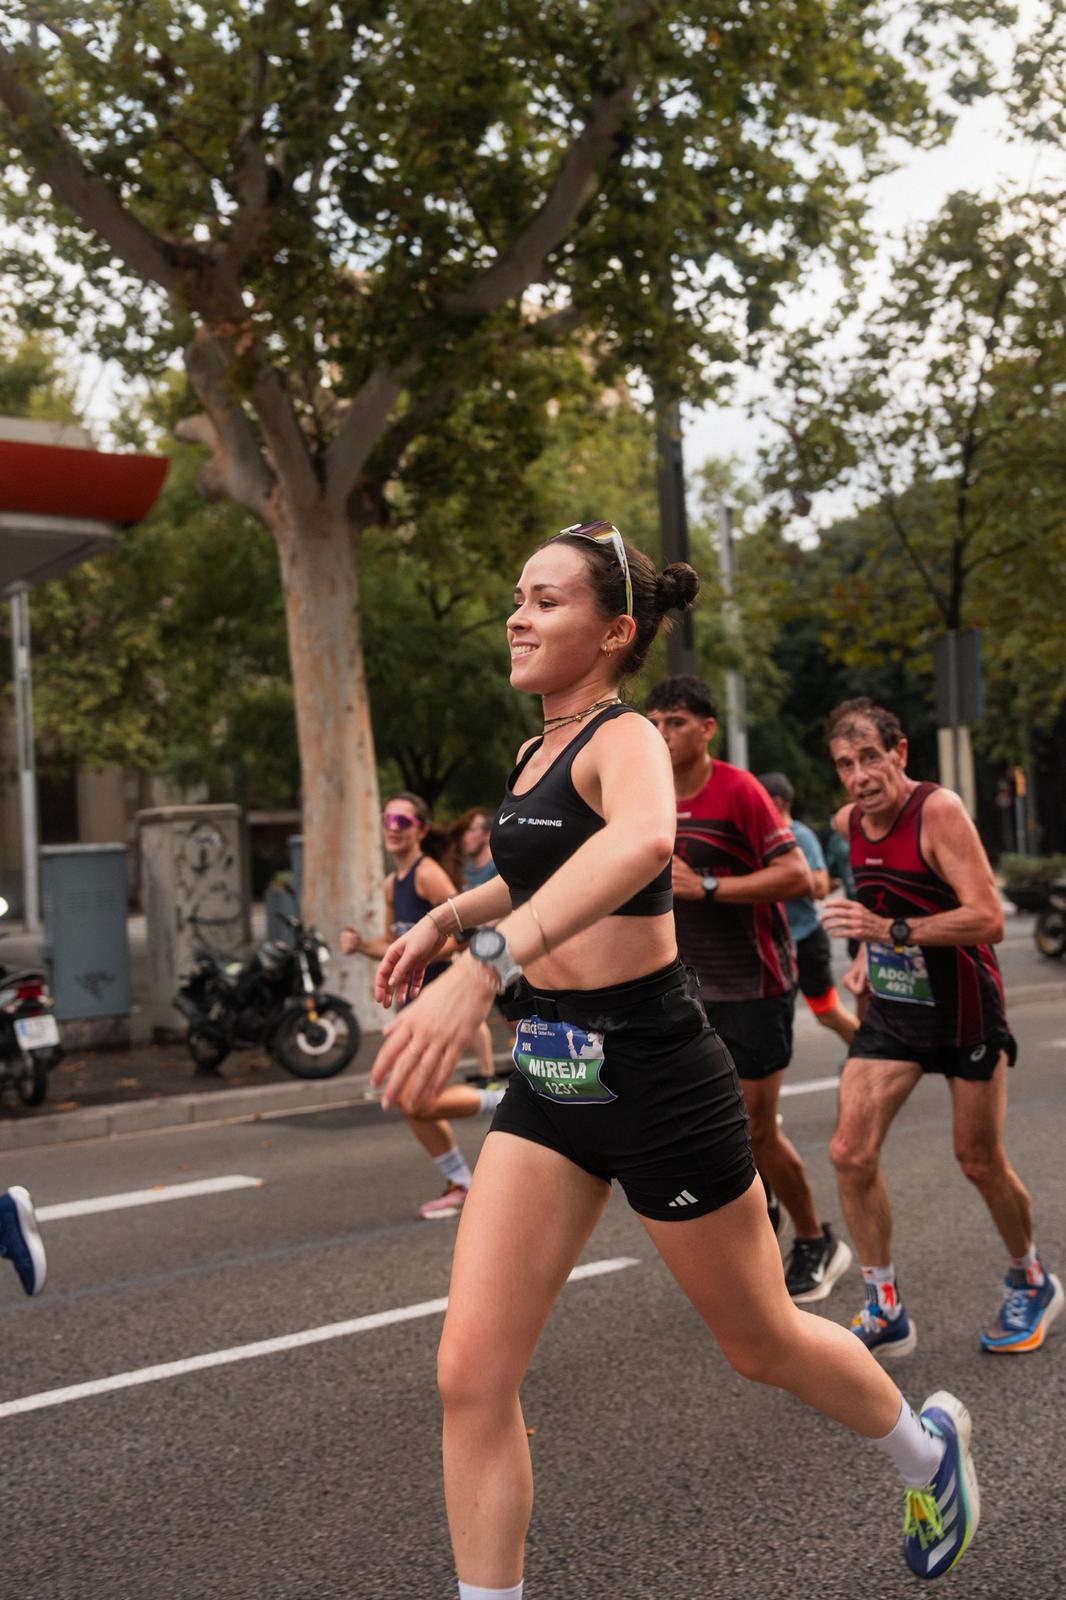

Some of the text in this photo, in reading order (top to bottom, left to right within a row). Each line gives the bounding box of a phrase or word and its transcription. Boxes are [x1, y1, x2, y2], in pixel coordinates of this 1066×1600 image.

[528, 818, 563, 827] RUNNING
[528, 1058, 587, 1079] MIREIA
[545, 1081, 579, 1095] 1231
